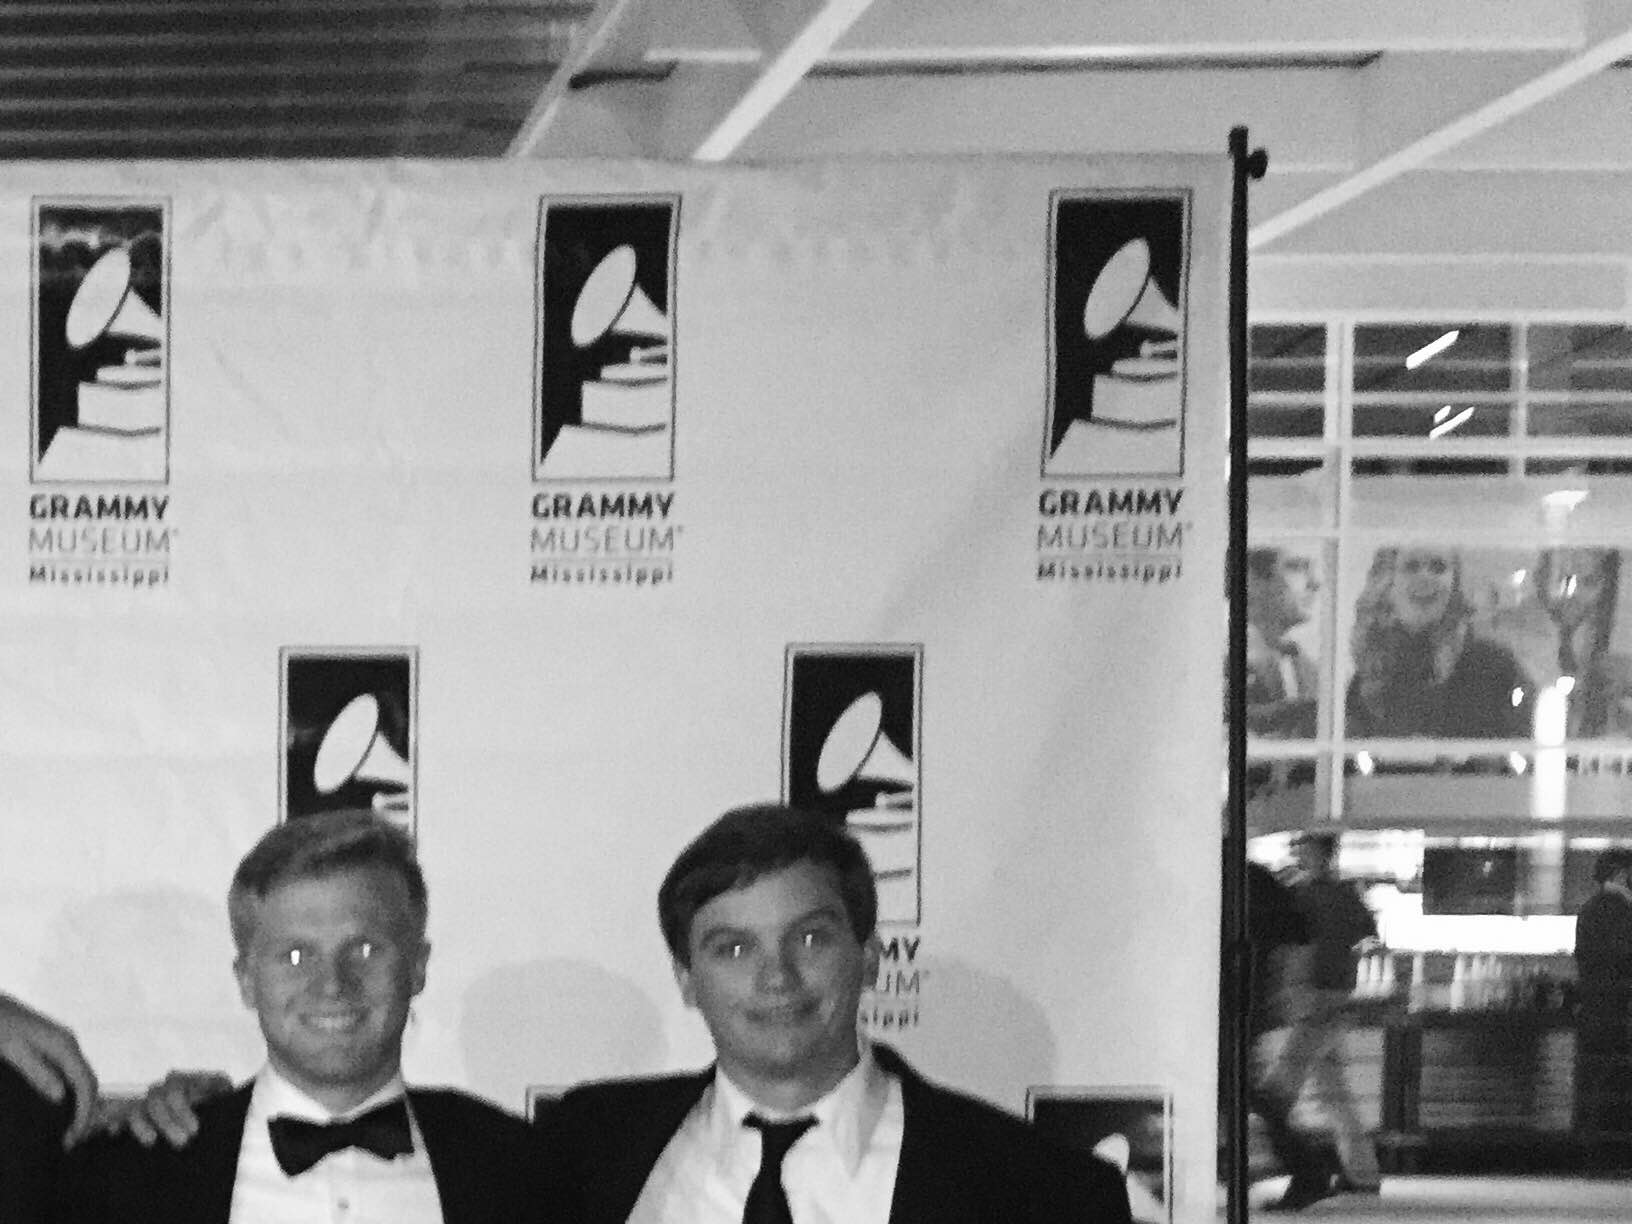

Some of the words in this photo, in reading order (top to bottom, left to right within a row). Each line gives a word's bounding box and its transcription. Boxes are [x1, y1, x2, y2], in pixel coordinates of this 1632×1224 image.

[29, 494, 170, 520] GRAMMY
[532, 492, 674, 519] GRAMMY
[1039, 488, 1183, 517] GRAMMY
[29, 566, 170, 591] Mississippi
[531, 564, 673, 586] Mississippi
[1037, 562, 1183, 583] Mississippi
